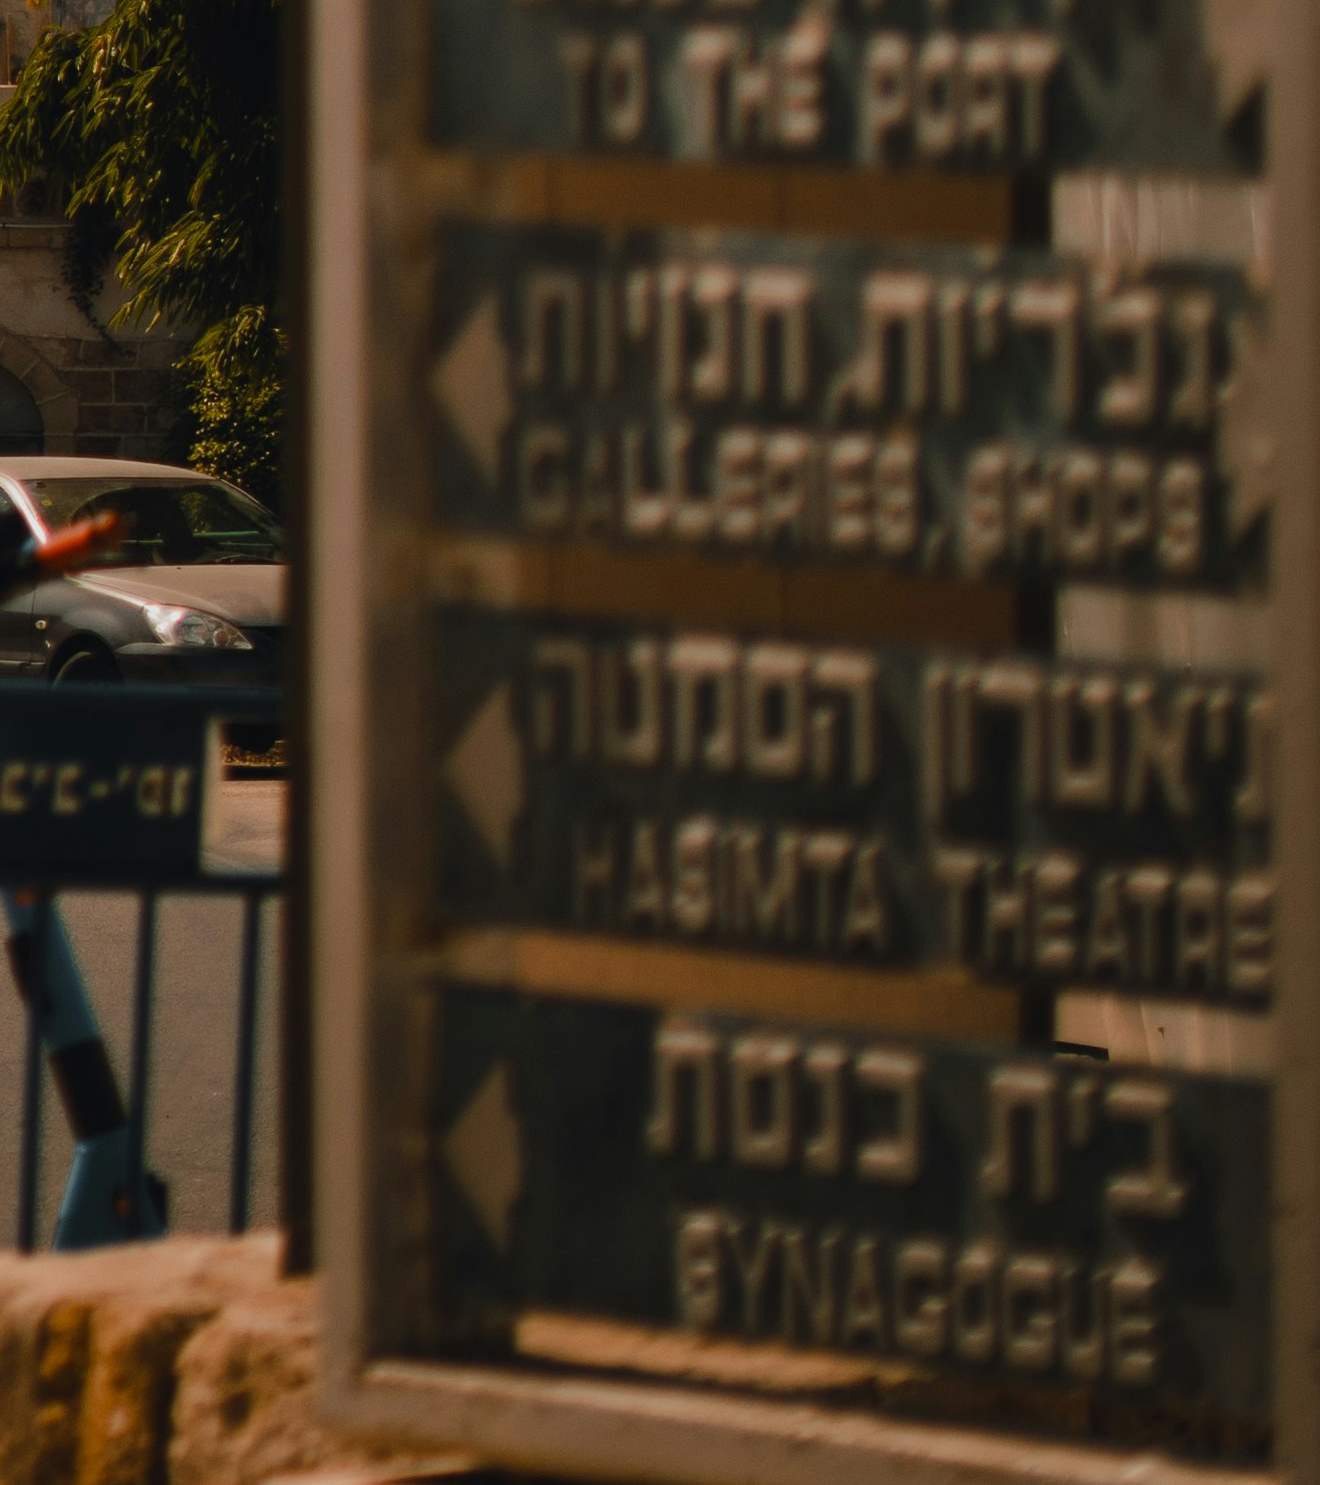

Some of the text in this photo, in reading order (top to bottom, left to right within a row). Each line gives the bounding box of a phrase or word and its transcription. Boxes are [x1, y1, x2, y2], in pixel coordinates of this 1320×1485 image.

[561, 20, 1069, 166] TO THE PORT
[963, 438, 1209, 580] SHOPS
[567, 810, 889, 954] HASIMTA
[643, 1022, 1193, 1222] בית כנסת
[673, 1202, 1163, 1390] SYNAGOGUE
